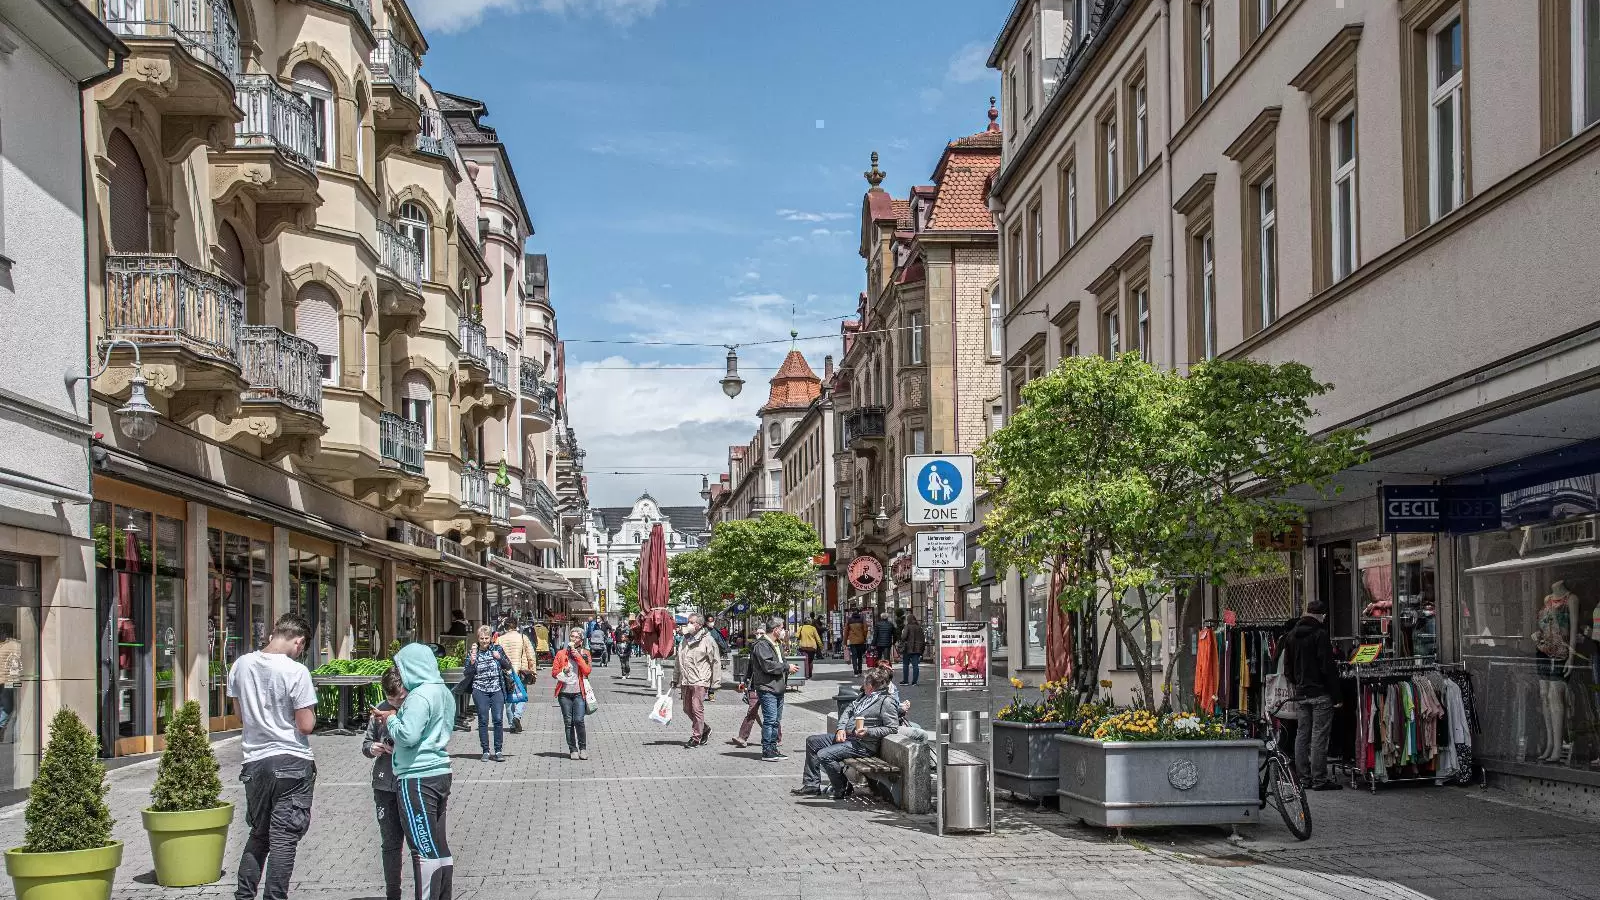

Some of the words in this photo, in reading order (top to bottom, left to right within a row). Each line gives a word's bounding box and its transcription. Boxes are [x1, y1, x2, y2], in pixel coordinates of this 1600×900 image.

[923, 508, 958, 520] ZONE
[1389, 502, 1440, 516] CECIL
[417, 824, 431, 853] adidas
